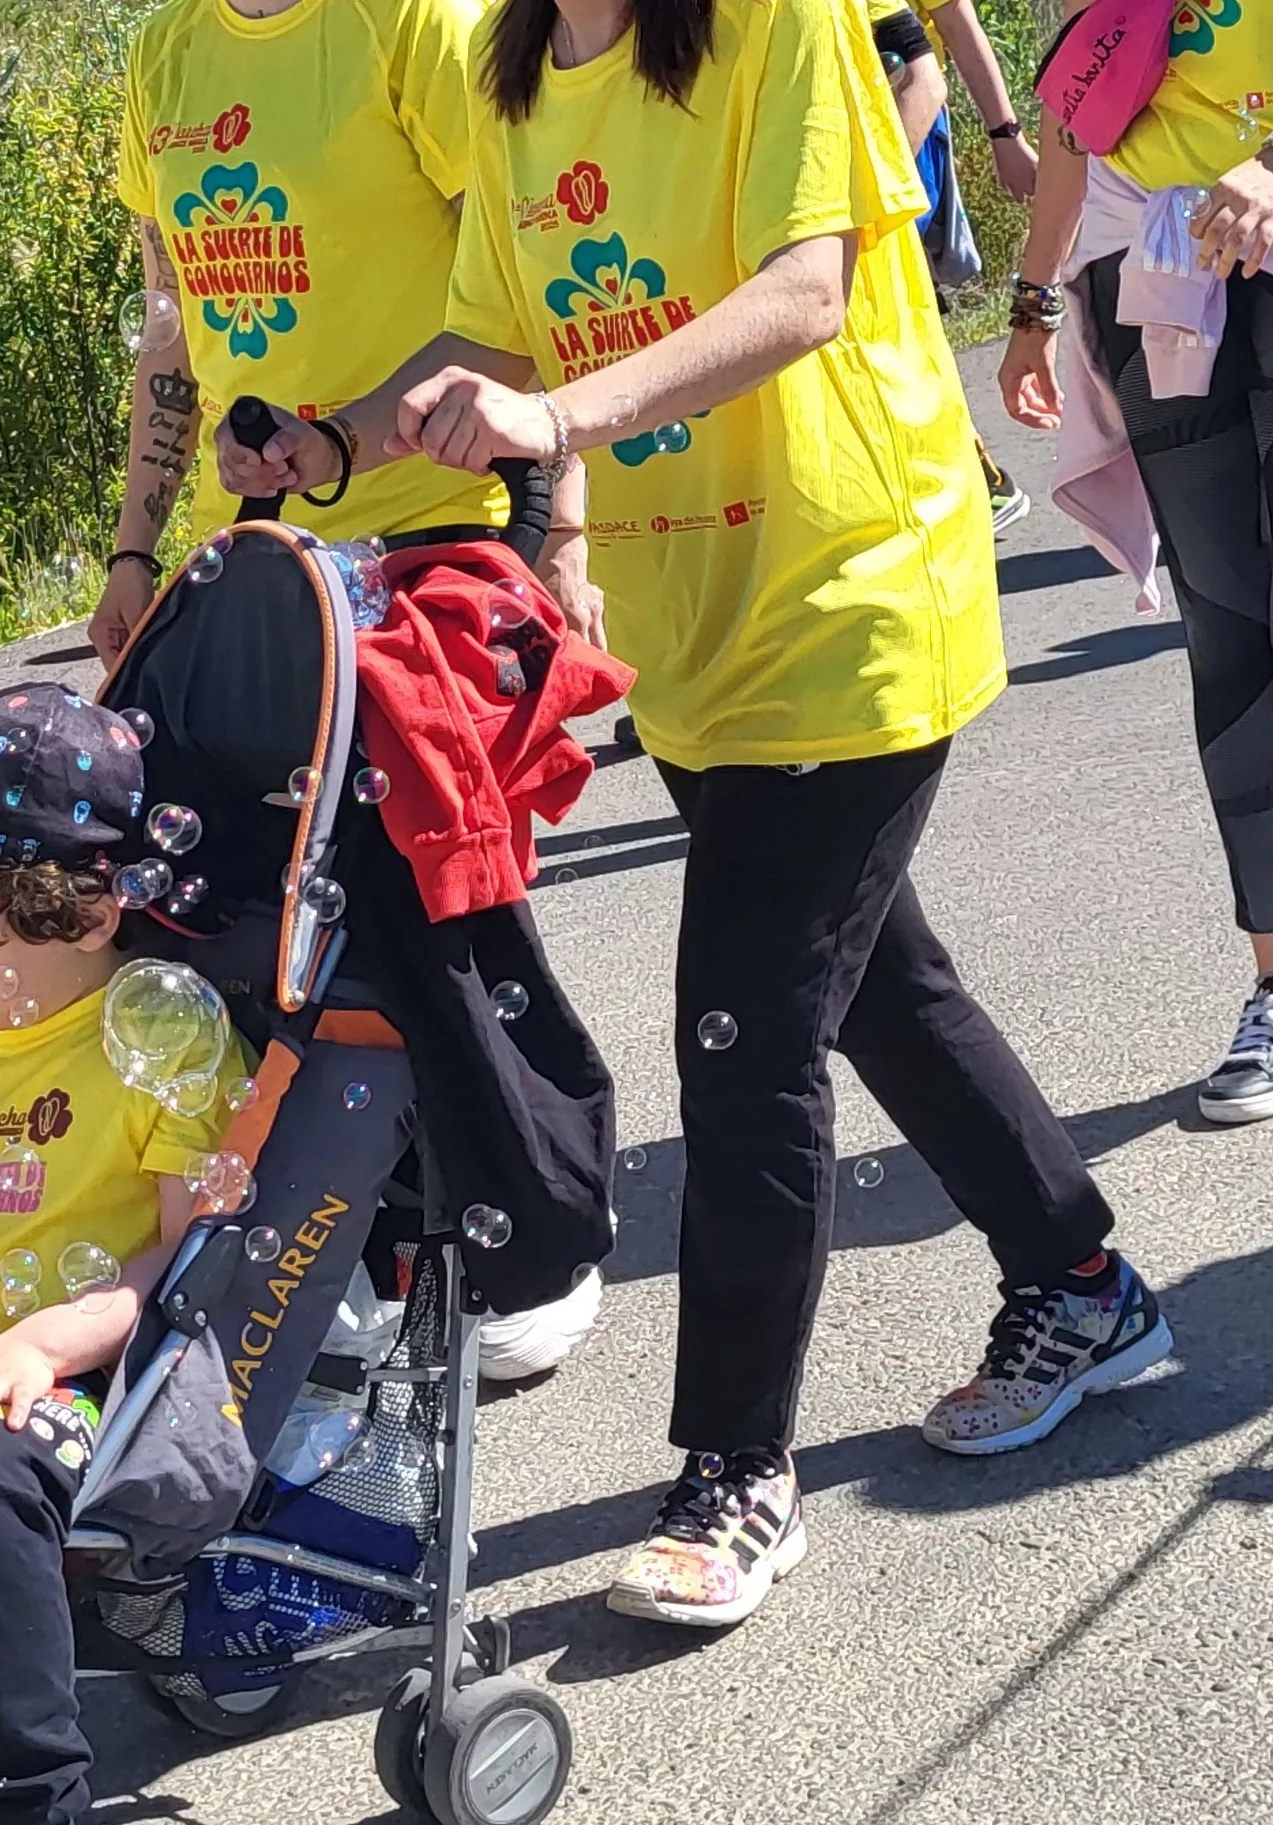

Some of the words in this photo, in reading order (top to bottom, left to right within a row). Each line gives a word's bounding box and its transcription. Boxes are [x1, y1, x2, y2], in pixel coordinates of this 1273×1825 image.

[172, 231, 202, 265] LA
[200, 226, 273, 262] SUERTE
[279, 225, 306, 258] DE
[183, 259, 310, 297] CONOCERNOS
[550, 323, 590, 362] LA
[587, 305, 664, 356] SUERTE
[221, 1193, 350, 1428] MACLAREN
